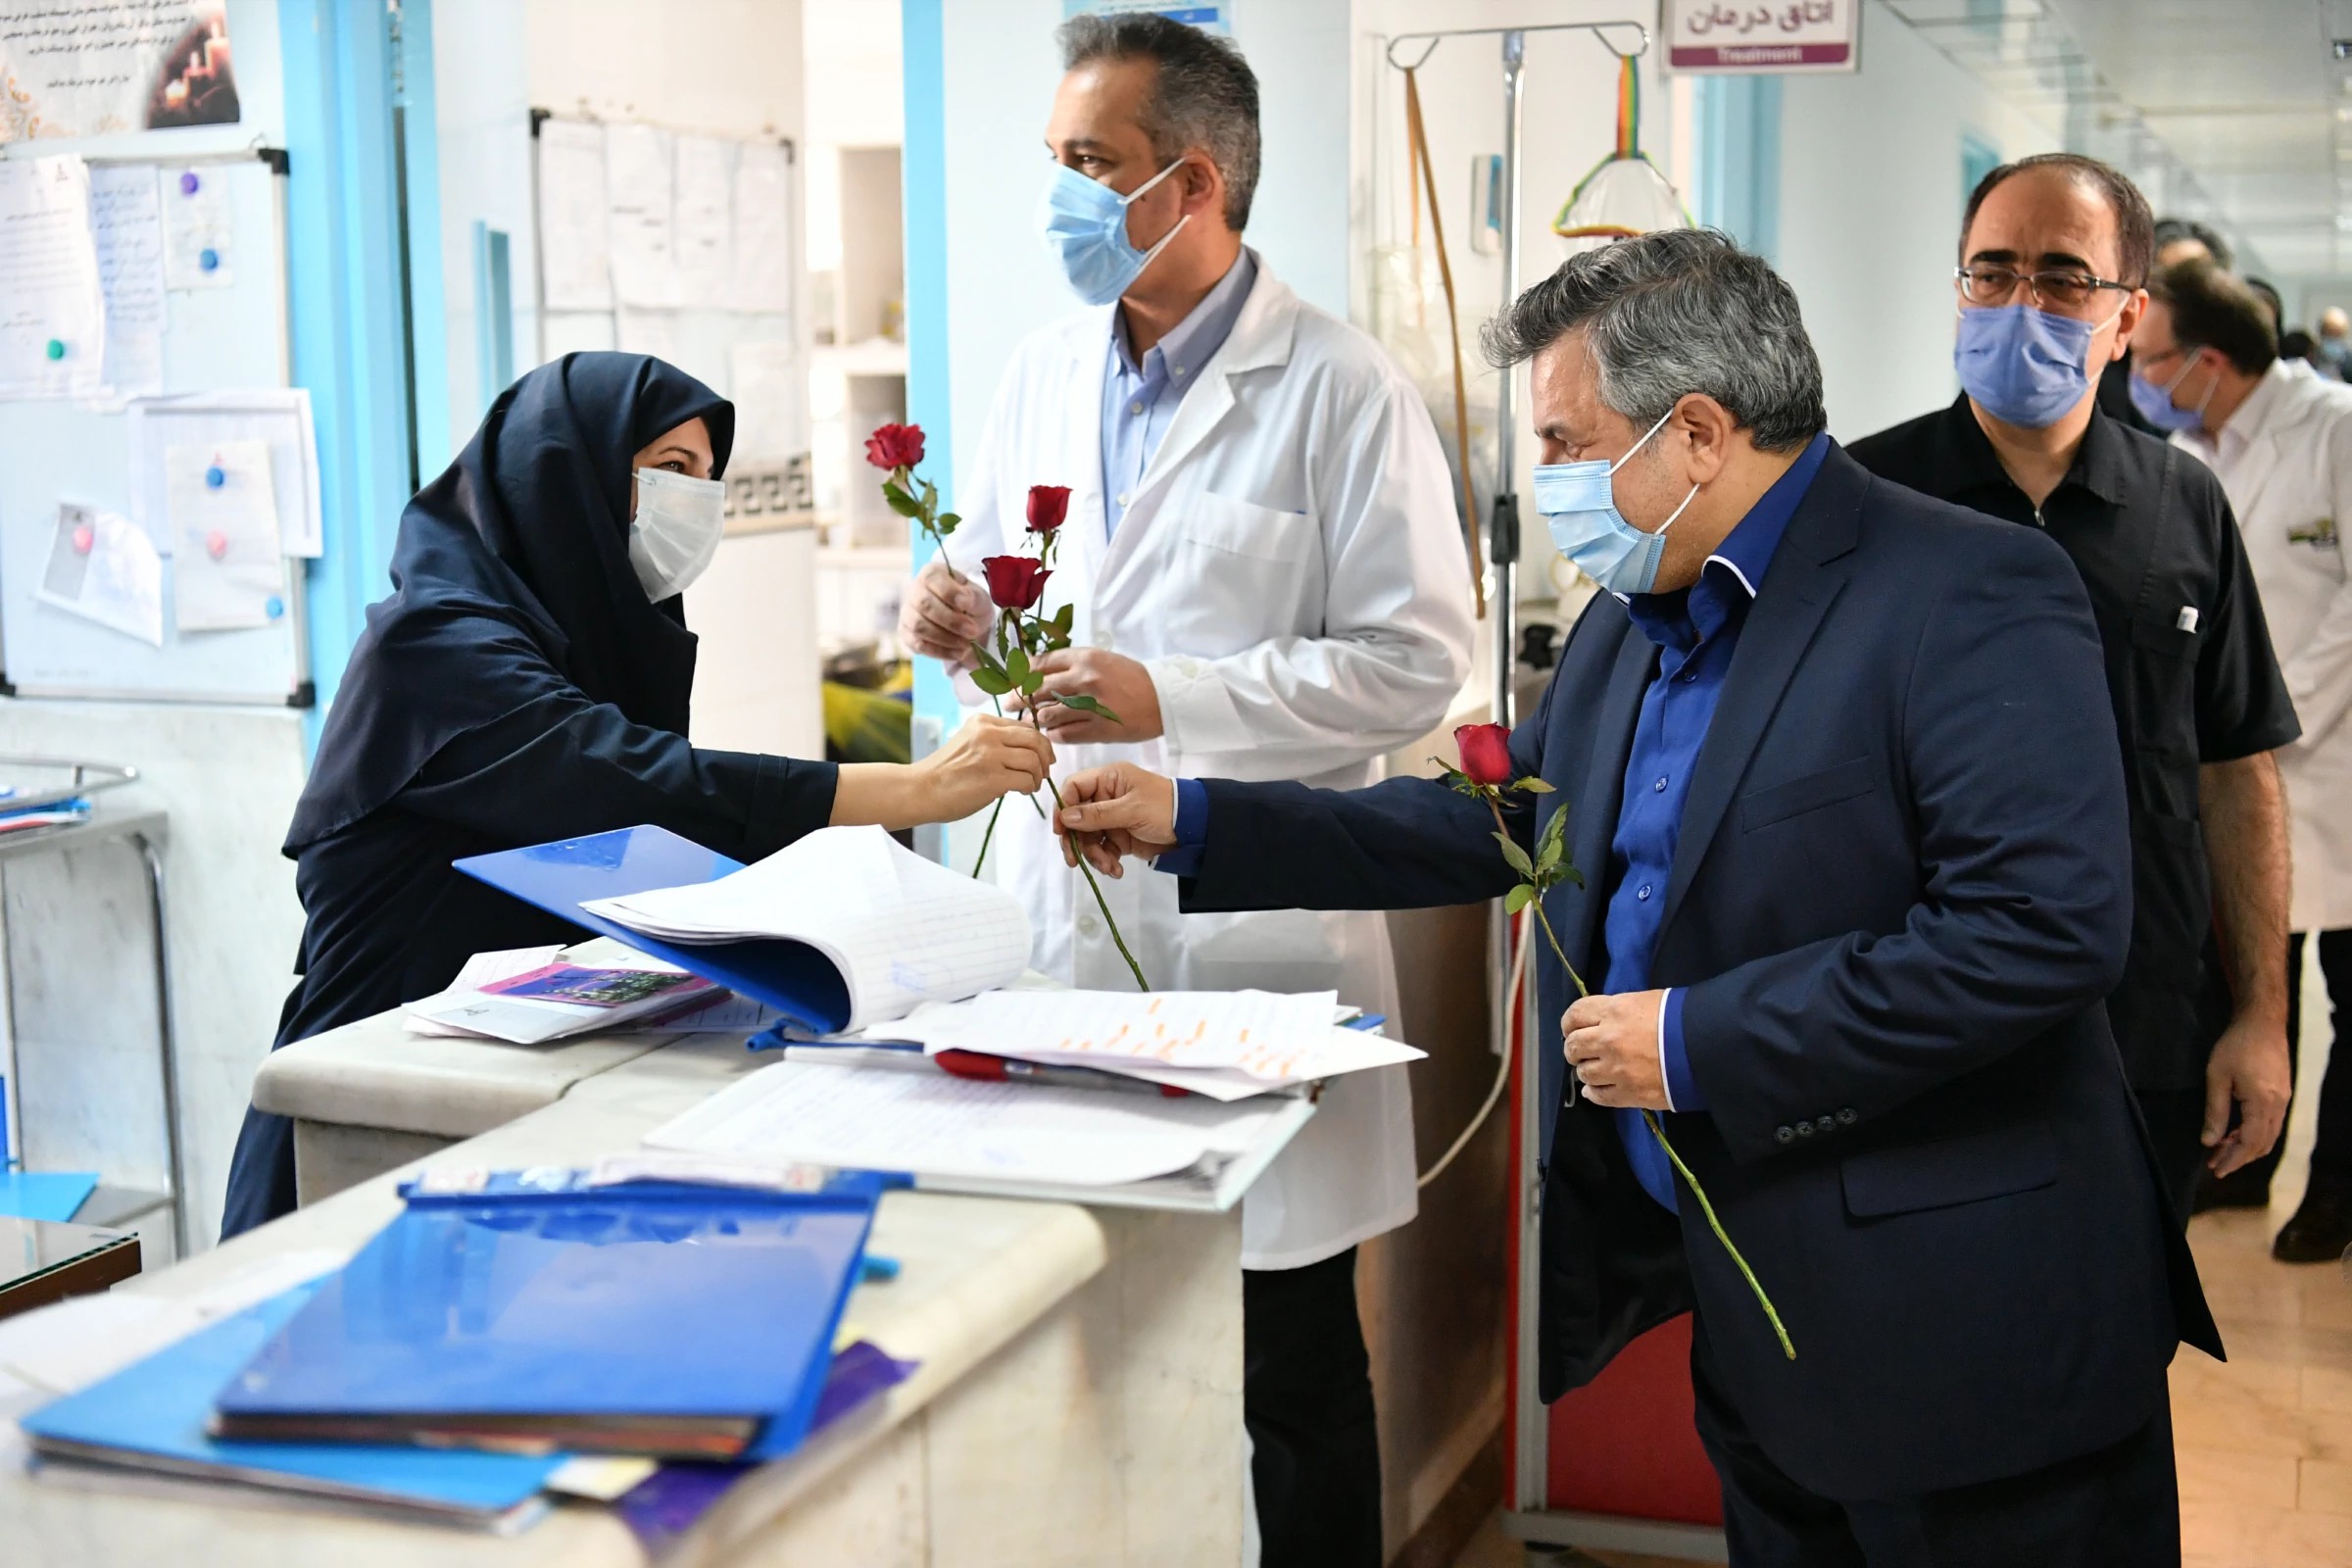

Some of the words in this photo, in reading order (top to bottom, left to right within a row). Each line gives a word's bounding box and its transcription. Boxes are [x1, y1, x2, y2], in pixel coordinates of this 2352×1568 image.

[1687, 2, 1772, 35] درمان
[1778, 0, 1835, 32] اتاق
[1718, 47, 1803, 65] Treatment
